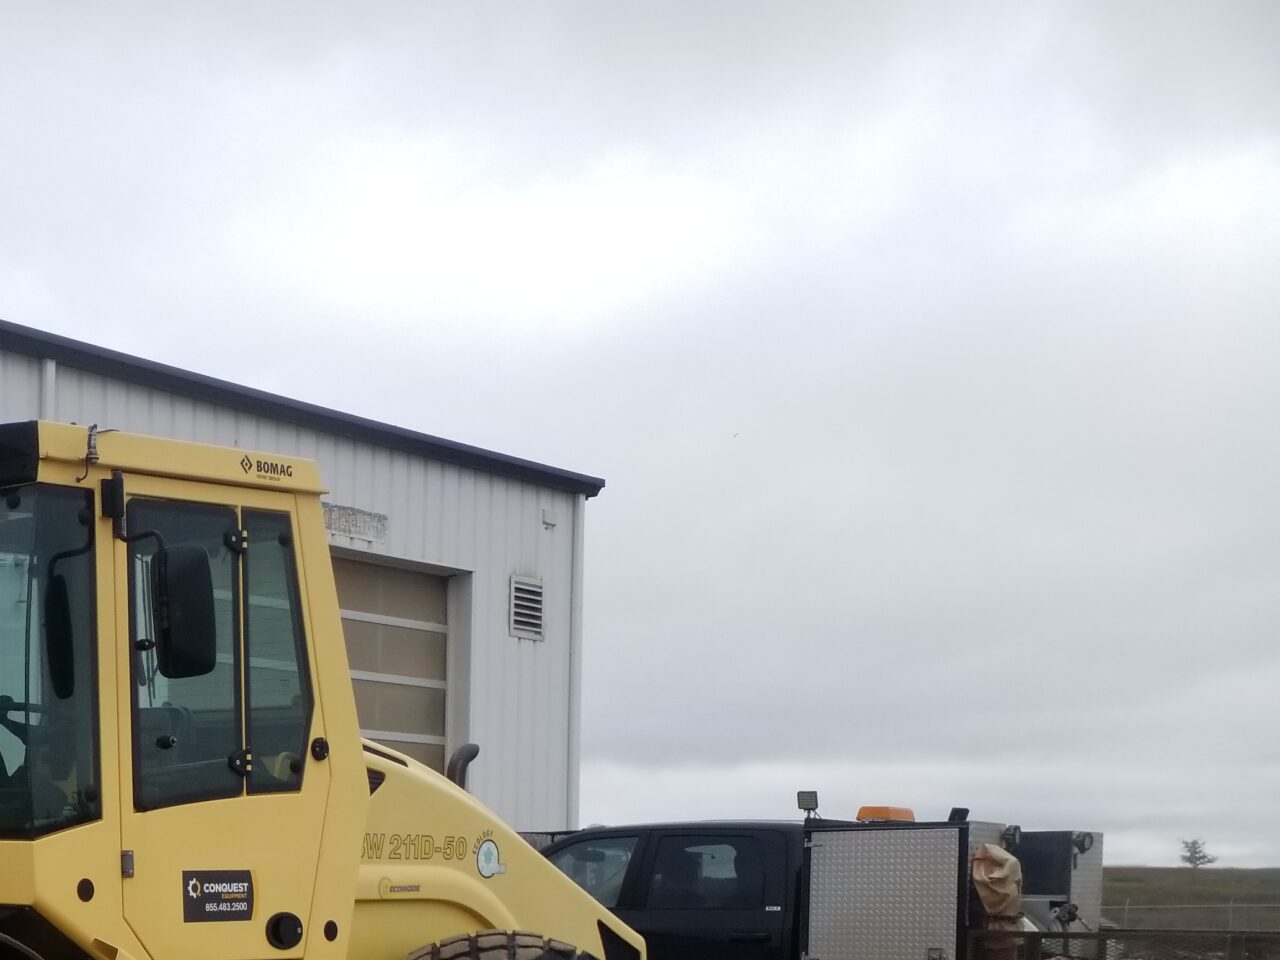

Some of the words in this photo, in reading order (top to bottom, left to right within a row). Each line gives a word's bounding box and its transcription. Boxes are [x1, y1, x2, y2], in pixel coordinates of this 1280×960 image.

[256, 460, 293, 477] BOMAG
[389, 832, 468, 861] 211D-50
[203, 882, 249, 893] CONQUEST
[205, 902, 248, 912] 855.483.2500
